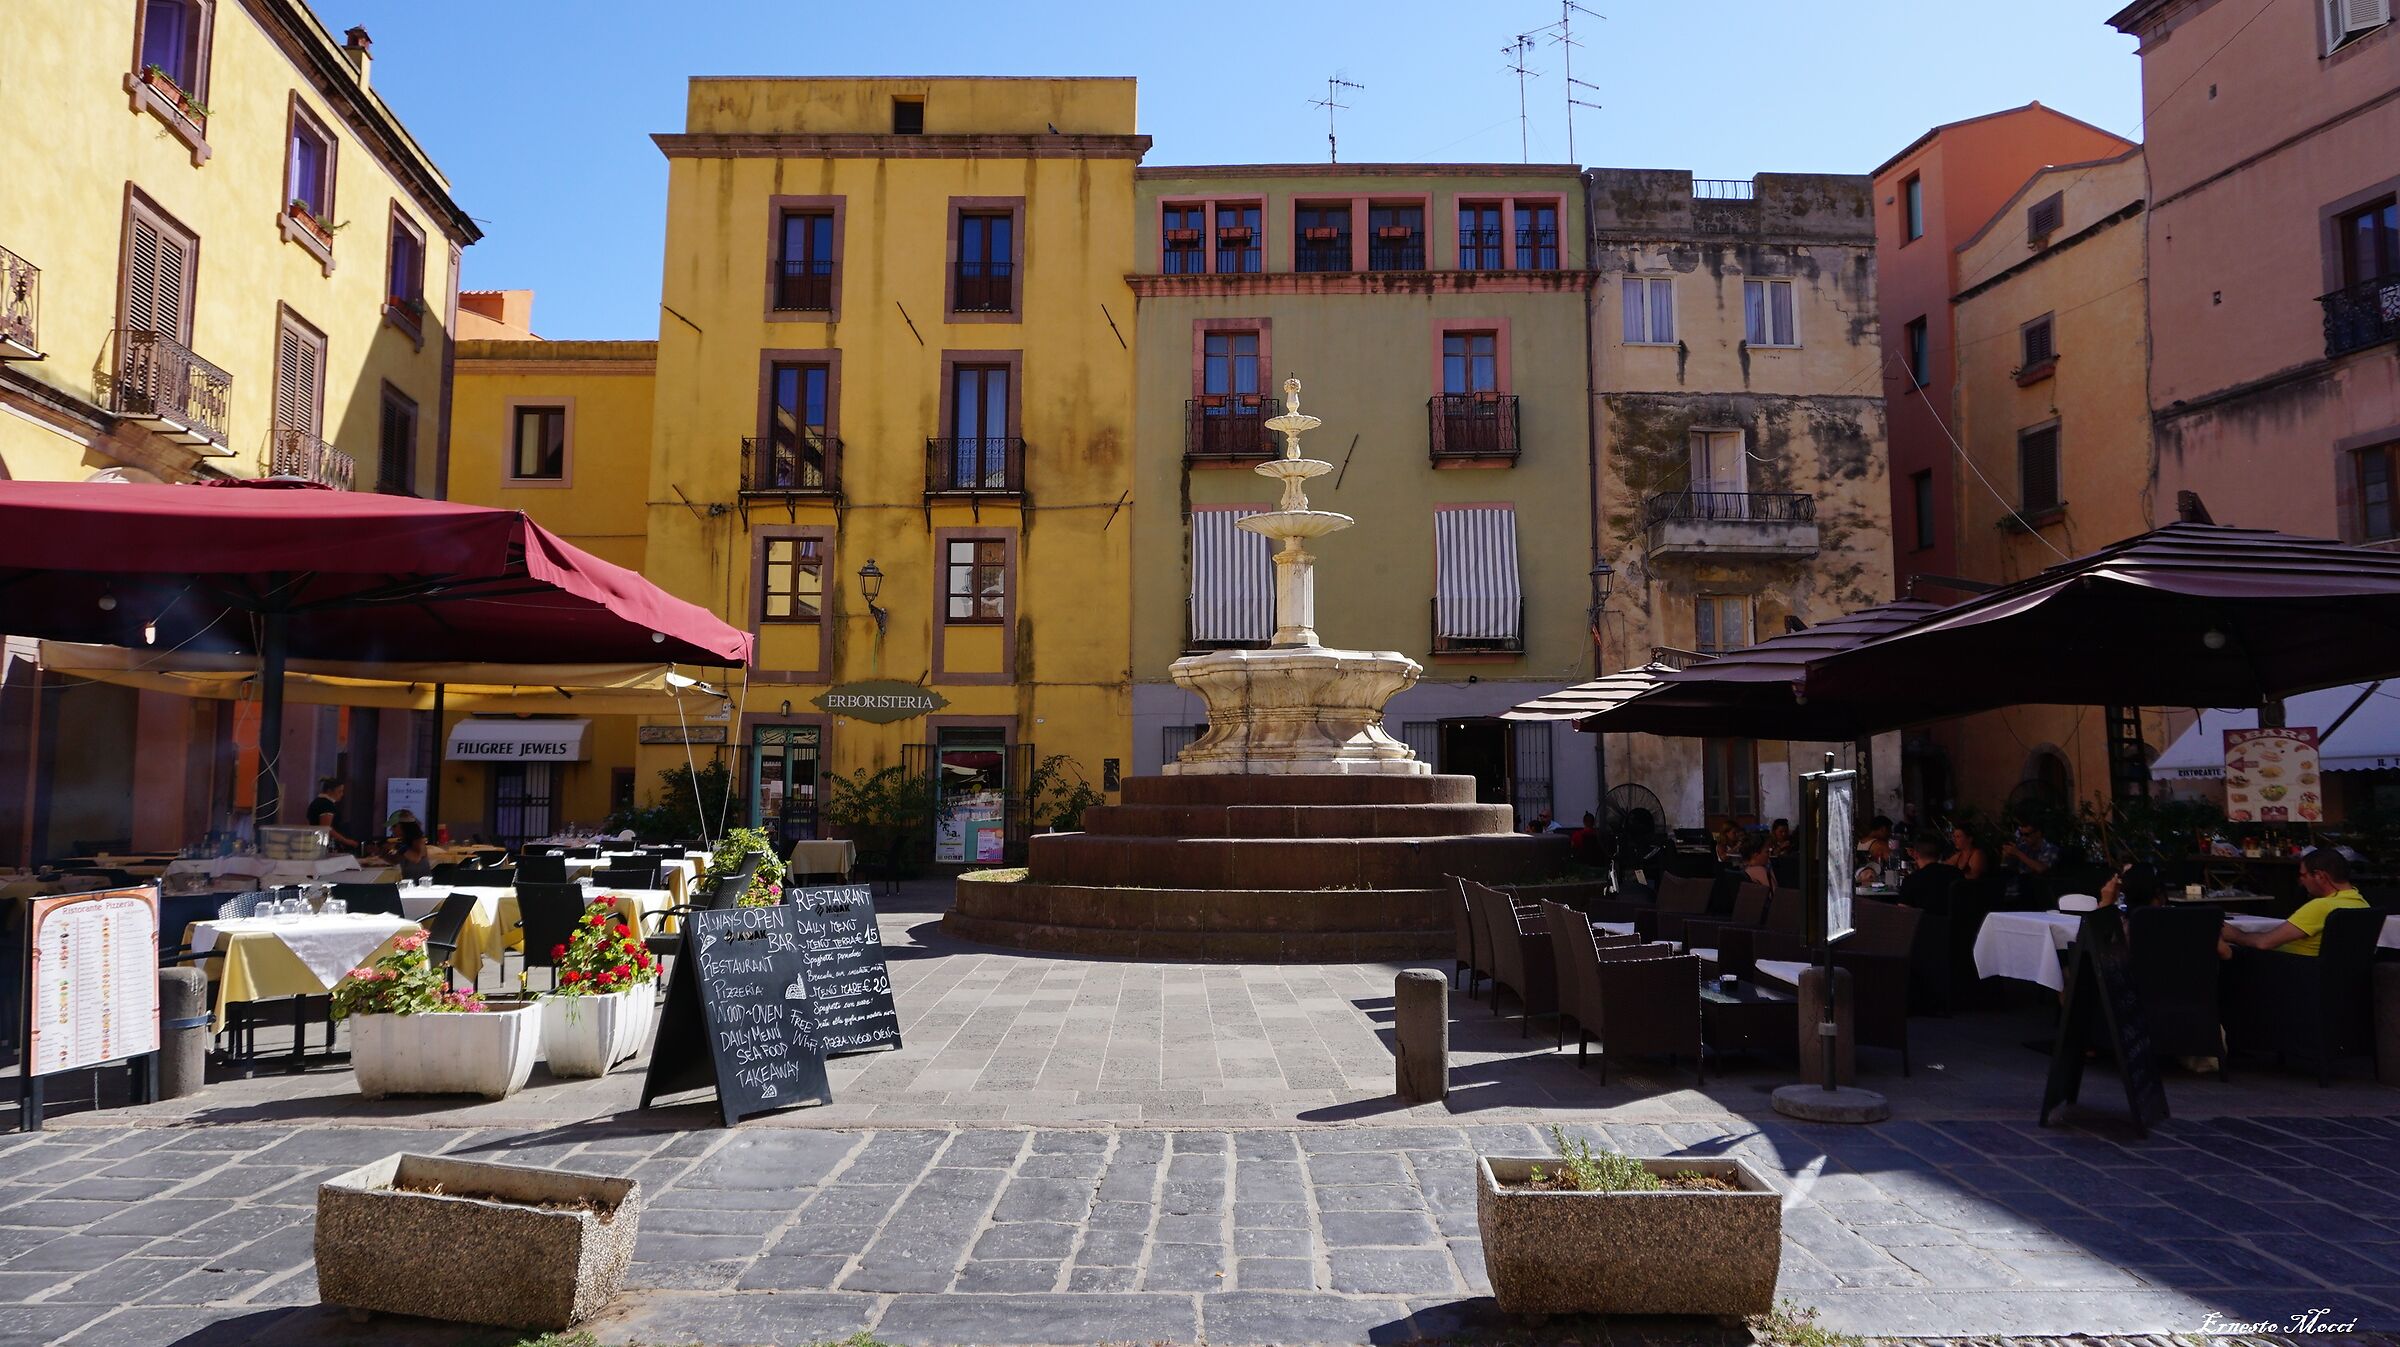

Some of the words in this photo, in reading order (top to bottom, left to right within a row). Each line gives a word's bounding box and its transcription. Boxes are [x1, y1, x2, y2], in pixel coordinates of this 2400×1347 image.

[828, 694, 934, 709] ERBORISTERIA
[2244, 729, 2297, 741] BAR
[456, 742, 514, 754] FILIGREE
[518, 742, 567, 757] JEWELS
[2178, 768, 2222, 777] RISTORANTE
[62, 903, 103, 915] Ristorante
[105, 900, 134, 910] Pizzeria
[792, 888, 871, 912] RESTAURANT
[697, 911, 742, 935] ALWAYS
[743, 908, 784, 929] OPEN
[797, 919, 826, 938] DAILY
[767, 932, 798, 953] BAR
[700, 953, 773, 982] RESTAURANT
[790, 1009, 814, 1034] FREE
[720, 1029, 752, 1053] DAILY
[736, 1046, 763, 1065] SEA
[760, 1042, 789, 1059] FOOD
[735, 1060, 800, 1088] TAKEAWAY
